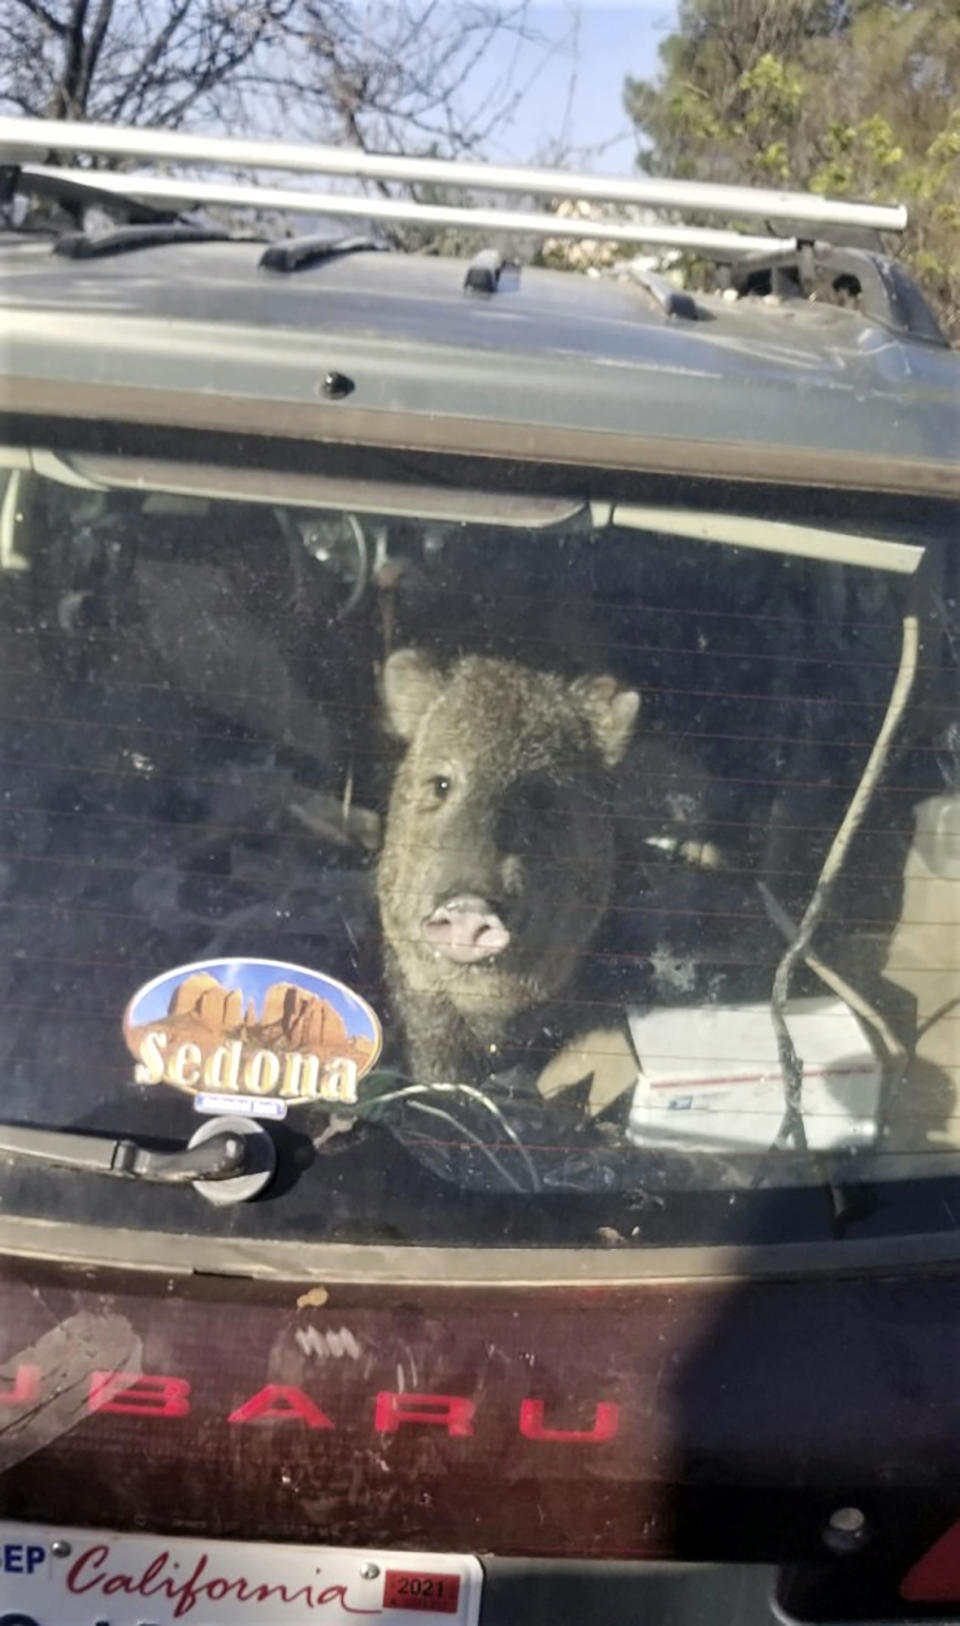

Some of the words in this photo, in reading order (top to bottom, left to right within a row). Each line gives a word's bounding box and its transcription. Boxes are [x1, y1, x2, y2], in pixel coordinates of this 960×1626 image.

[134, 1031, 358, 1104] Sedona
[0, 1545, 46, 1574] EP
[66, 1545, 382, 1618] California
[397, 1577, 444, 1598] 2021
